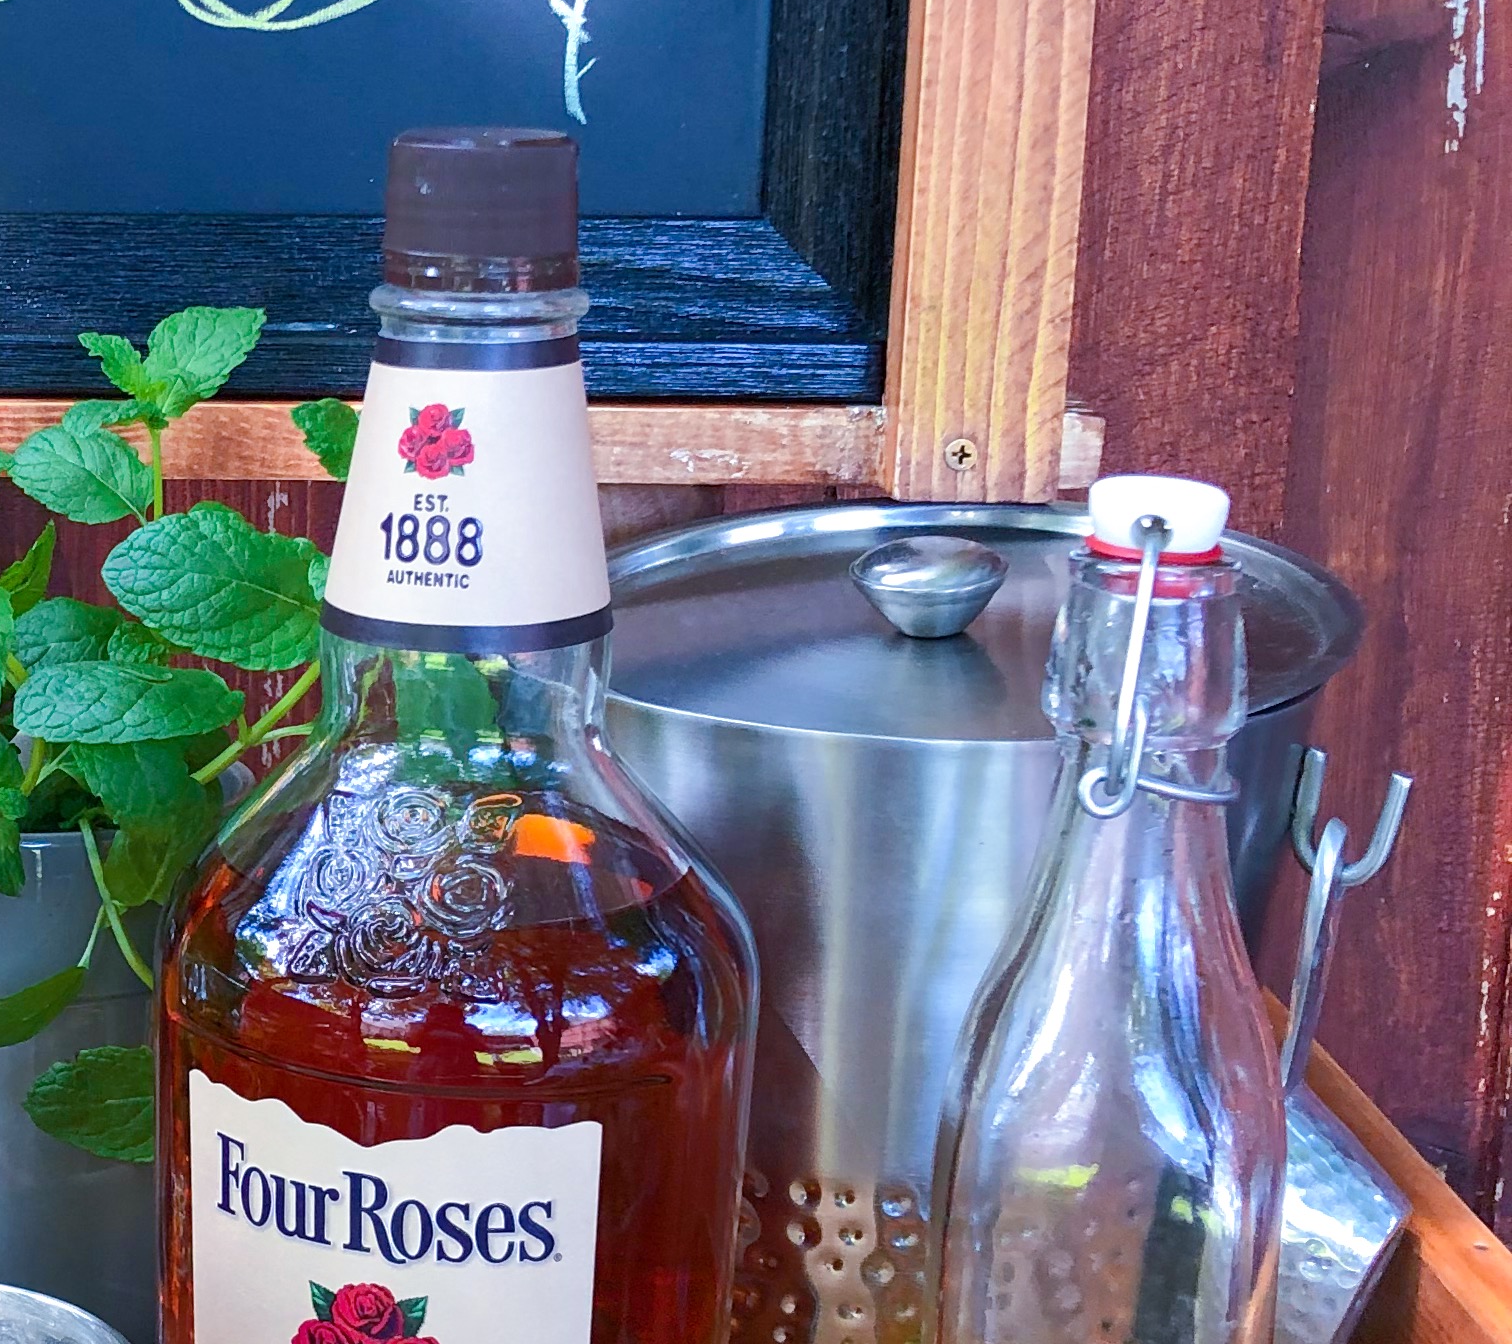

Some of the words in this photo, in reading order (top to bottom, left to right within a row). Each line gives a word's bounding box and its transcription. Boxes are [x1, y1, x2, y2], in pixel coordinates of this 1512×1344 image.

[413, 493, 450, 513] EST.
[379, 512, 484, 568] 1888
[386, 569, 471, 590] AUTHENTIC
[216, 1130, 341, 1246] Four
[342, 1170, 557, 1265] Roses
